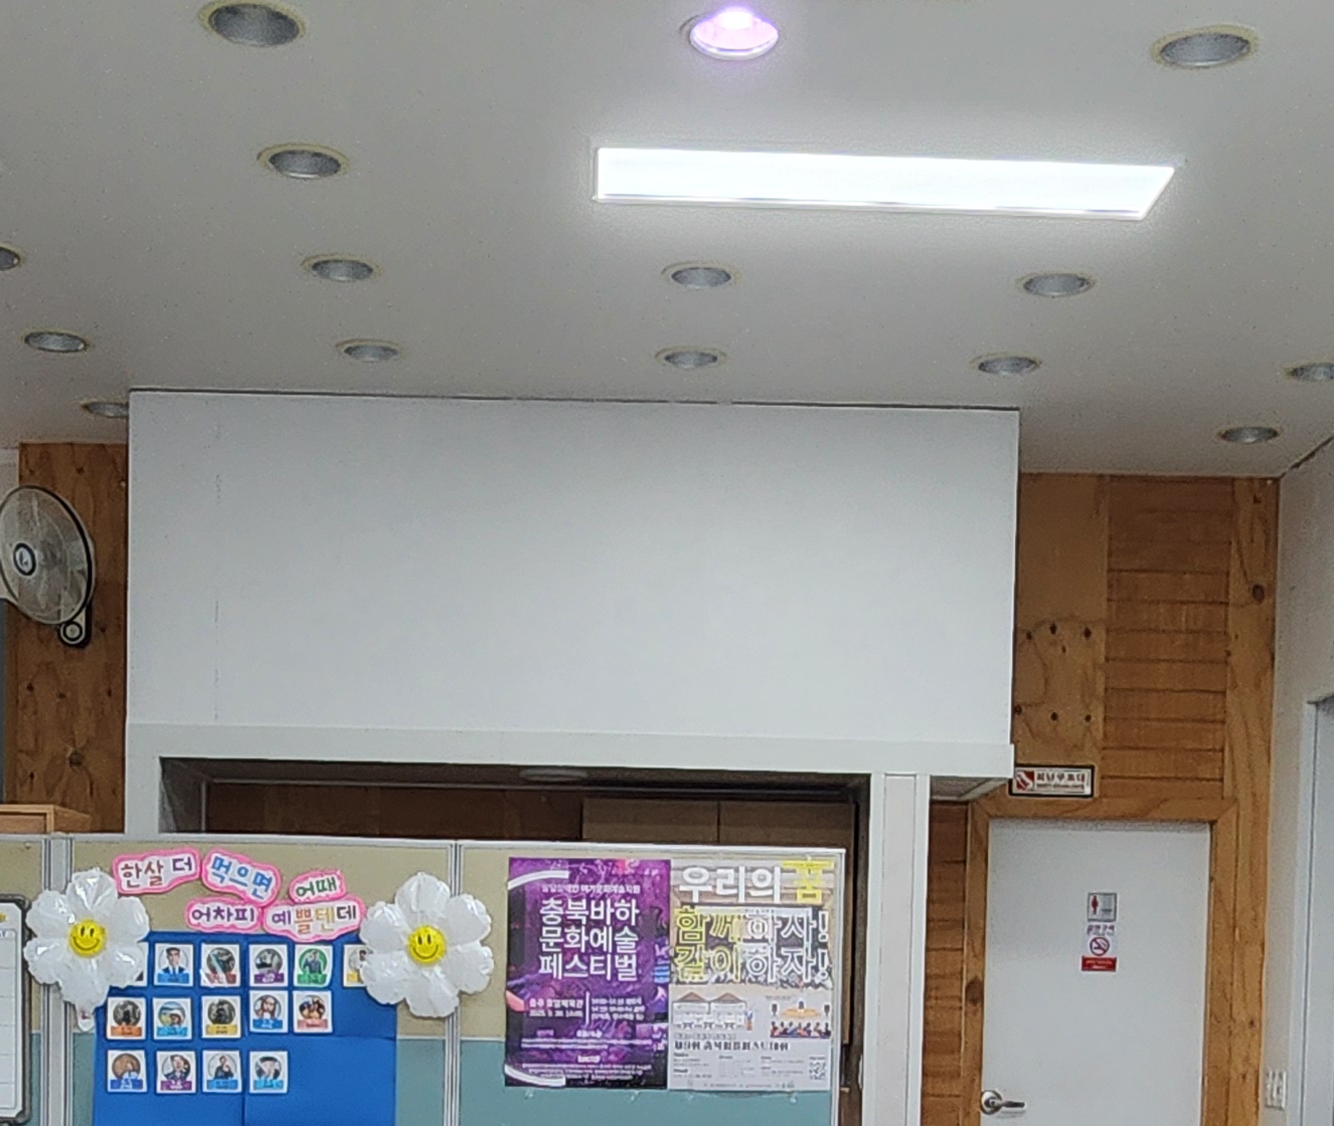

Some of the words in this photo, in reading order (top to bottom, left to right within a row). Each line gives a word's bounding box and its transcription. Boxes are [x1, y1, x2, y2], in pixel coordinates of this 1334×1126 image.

[121, 860, 164, 889] 한살
[172, 856, 193, 875] 더
[211, 855, 273, 900] 먹으면
[678, 866, 781, 904] 우리의
[296, 877, 338, 898] 어때
[191, 906, 255, 923] 어차피
[271, 904, 356, 935] 예쁠텐데
[539, 897, 641, 926] 충북바하
[539, 925, 639, 954] 문화예술
[538, 953, 638, 982] 페스티벌
